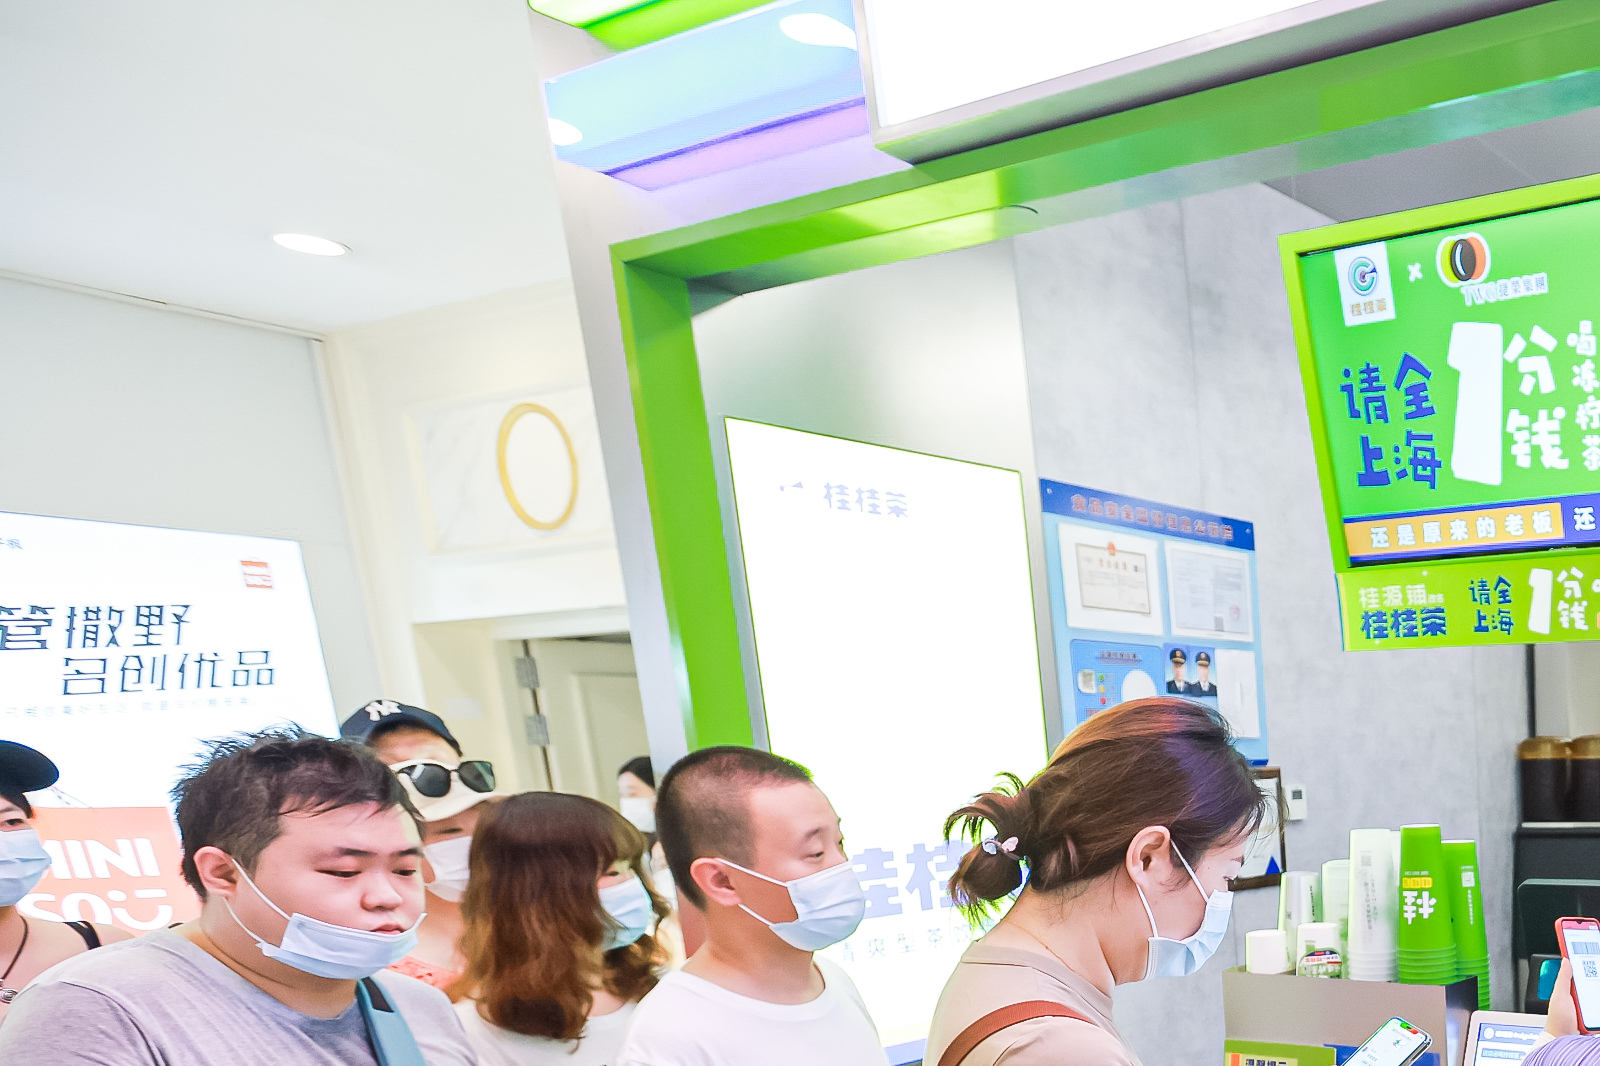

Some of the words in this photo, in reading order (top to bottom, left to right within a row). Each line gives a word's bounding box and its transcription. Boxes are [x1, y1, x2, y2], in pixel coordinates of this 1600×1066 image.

[1341, 352, 1432, 425] 请全
[1357, 430, 1443, 490] 上海
[1369, 509, 1554, 549] 还是原来的老板
[1468, 575, 1512, 605] 请全
[1361, 607, 1447, 639] 桂桂茶
[1474, 608, 1514, 635] 上海
[63, 650, 274, 695] 名创优品
